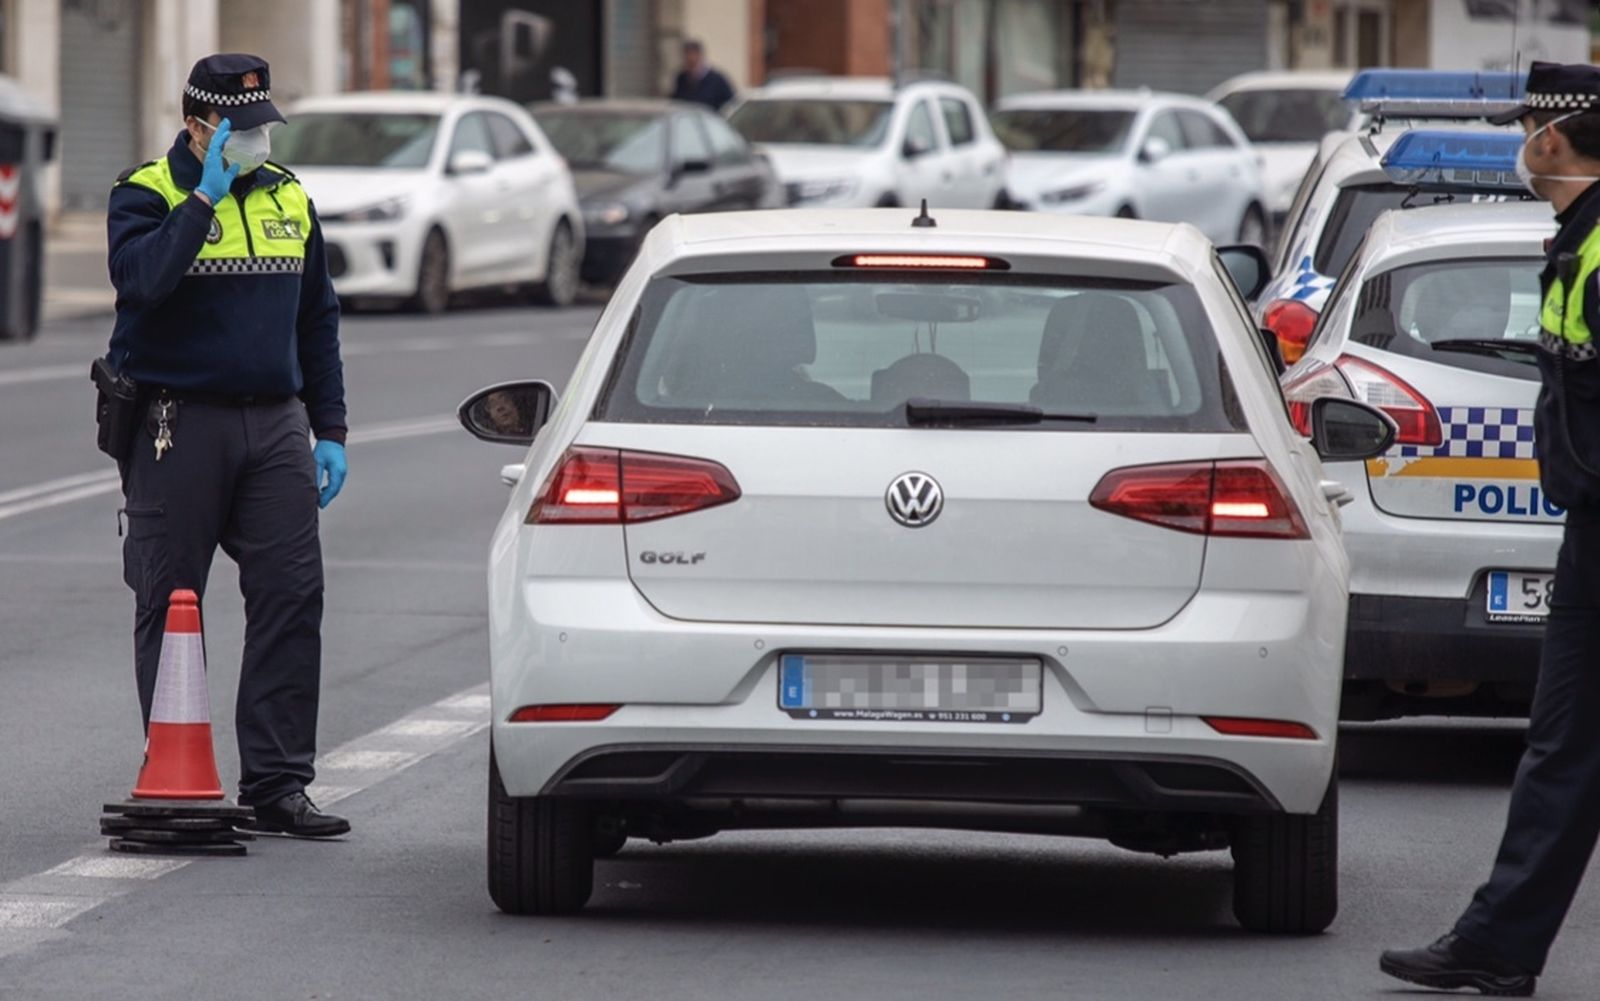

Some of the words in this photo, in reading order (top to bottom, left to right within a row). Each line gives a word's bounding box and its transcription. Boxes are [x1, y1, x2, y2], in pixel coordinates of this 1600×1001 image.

[639, 550, 706, 564] GOLF
[1494, 595, 1503, 605] E
[788, 686, 797, 698] E
